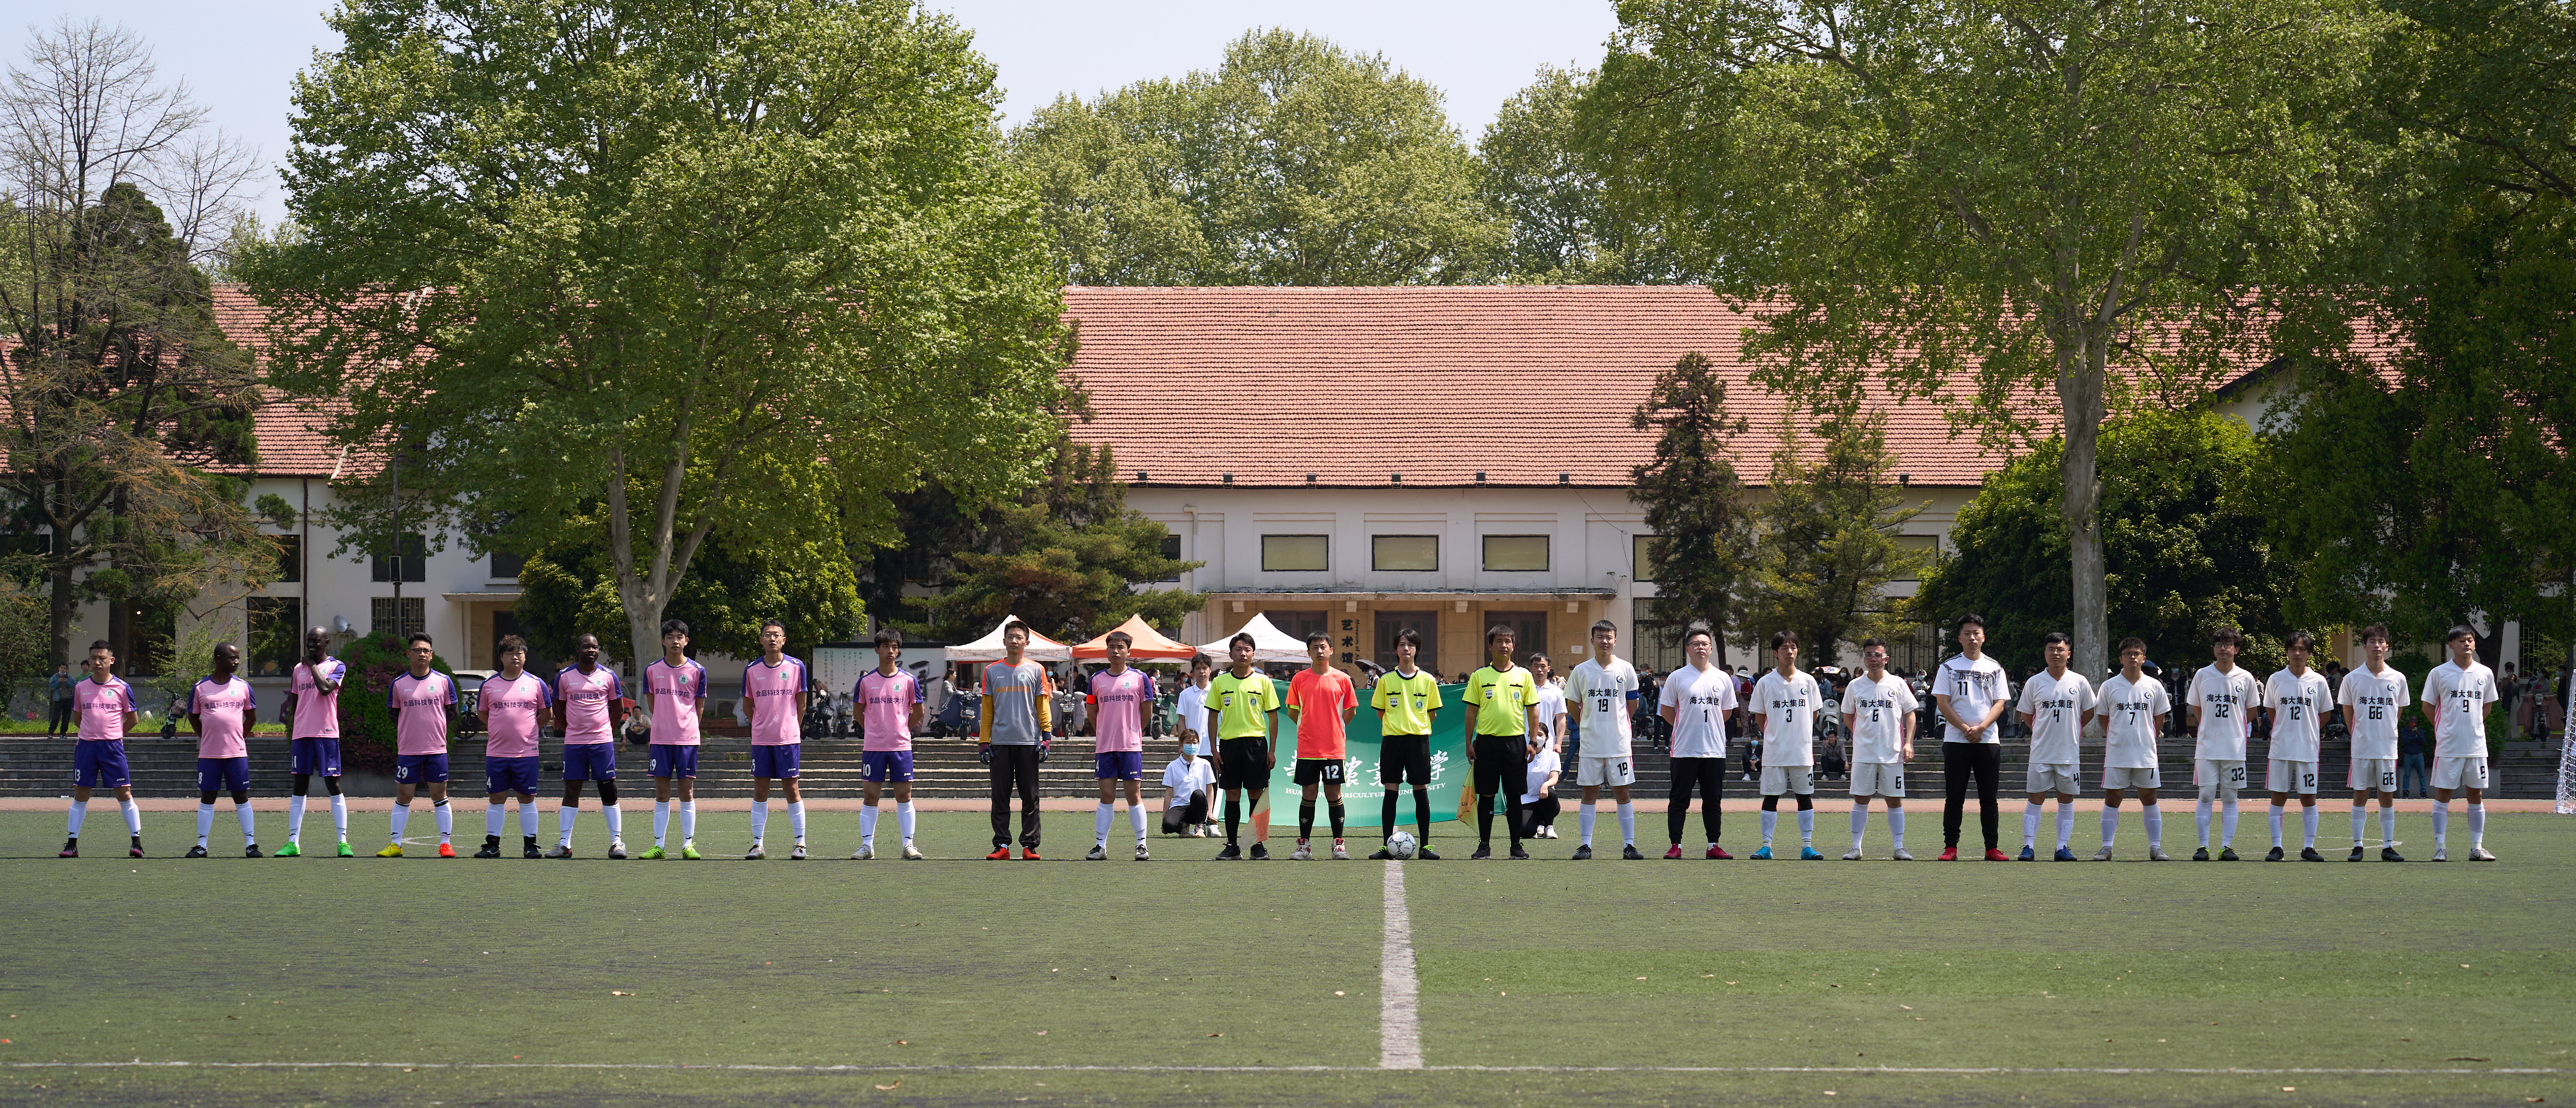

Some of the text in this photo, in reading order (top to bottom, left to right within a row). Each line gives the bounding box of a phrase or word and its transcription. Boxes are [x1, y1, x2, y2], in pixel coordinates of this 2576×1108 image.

[1341, 619, 1353, 663] 艺术馆
[655, 688, 689, 698] 食品科技学院
[756, 689, 792, 697] 食品科技学院
[1588, 688, 1618, 697] 海大集团
[1958, 681, 1968, 695] 11
[2451, 690, 2482, 699] 海大集团
[403, 699, 440, 707] 食品科技学院
[1099, 695, 1134, 703] 食品科技学院
[1598, 699, 1608, 712] 19
[1690, 696, 1719, 706] 海大集团
[1773, 699, 1806, 709] 海大集团
[1860, 699, 1893, 708] 海大集团
[2042, 699, 2073, 709] 海大集团
[2206, 694, 2238, 705] 海大集团
[2280, 696, 2311, 706] 海大集团
[2360, 696, 2393, 706] 海大集团
[2117, 702, 2148, 711] 海大集团
[2216, 704, 2229, 718] 32
[2463, 699, 2469, 713] 9
[1703, 709, 1708, 723] 1
[1786, 709, 1792, 723] 3
[1872, 709, 1879, 722] 6
[2053, 709, 2060, 723] 4
[2129, 712, 2135, 725] 7
[2290, 706, 2300, 720] 12
[2369, 706, 2382, 720] 66
[74, 769, 81, 782] 13
[397, 766, 408, 779] 29
[863, 763, 871, 776] 10
[1325, 765, 1339, 780] 12
[1618, 762, 1628, 776] 19
[2232, 767, 2244, 781] 32
[2480, 766, 2486, 779] 9
[198, 772, 203, 784] 8
[1808, 773, 1813, 786] 3
[1895, 776, 1901, 789] 6
[2073, 773, 2079, 786] 4
[2303, 773, 2315, 787] 12
[2383, 772, 2394, 785] 66
[1398, 783, 1446, 795] UNISITY
